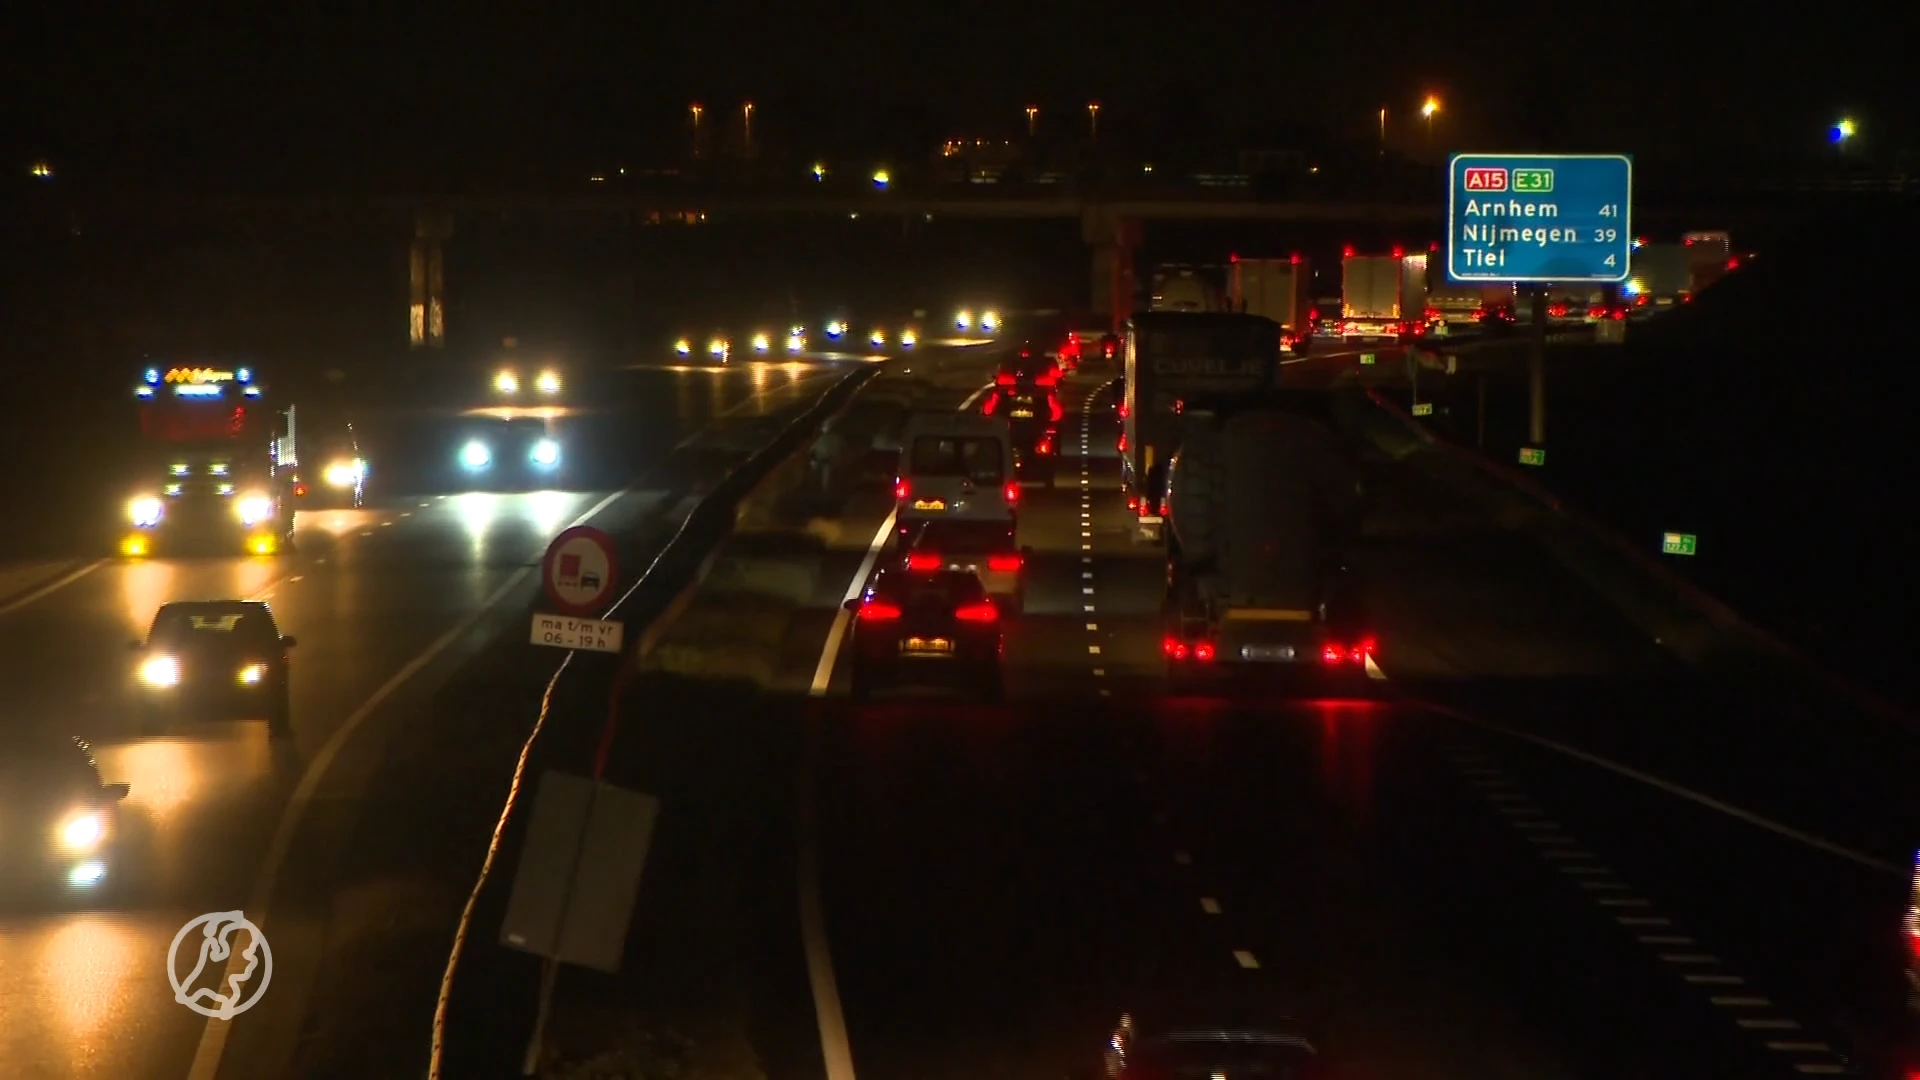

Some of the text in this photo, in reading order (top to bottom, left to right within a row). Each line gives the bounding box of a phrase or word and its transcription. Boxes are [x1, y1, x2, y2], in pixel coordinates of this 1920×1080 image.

[1468, 172, 1504, 188] A15
[1464, 199, 1618, 218] Arnhem 41
[1463, 224, 1617, 247] Nijmegen 39
[1463, 249, 1617, 268] Tiel 4
[541, 620, 614, 635] ma t/m vr
[544, 632, 562, 644] 06
[580, 636, 593, 647] 19
[597, 637, 606, 648] h
